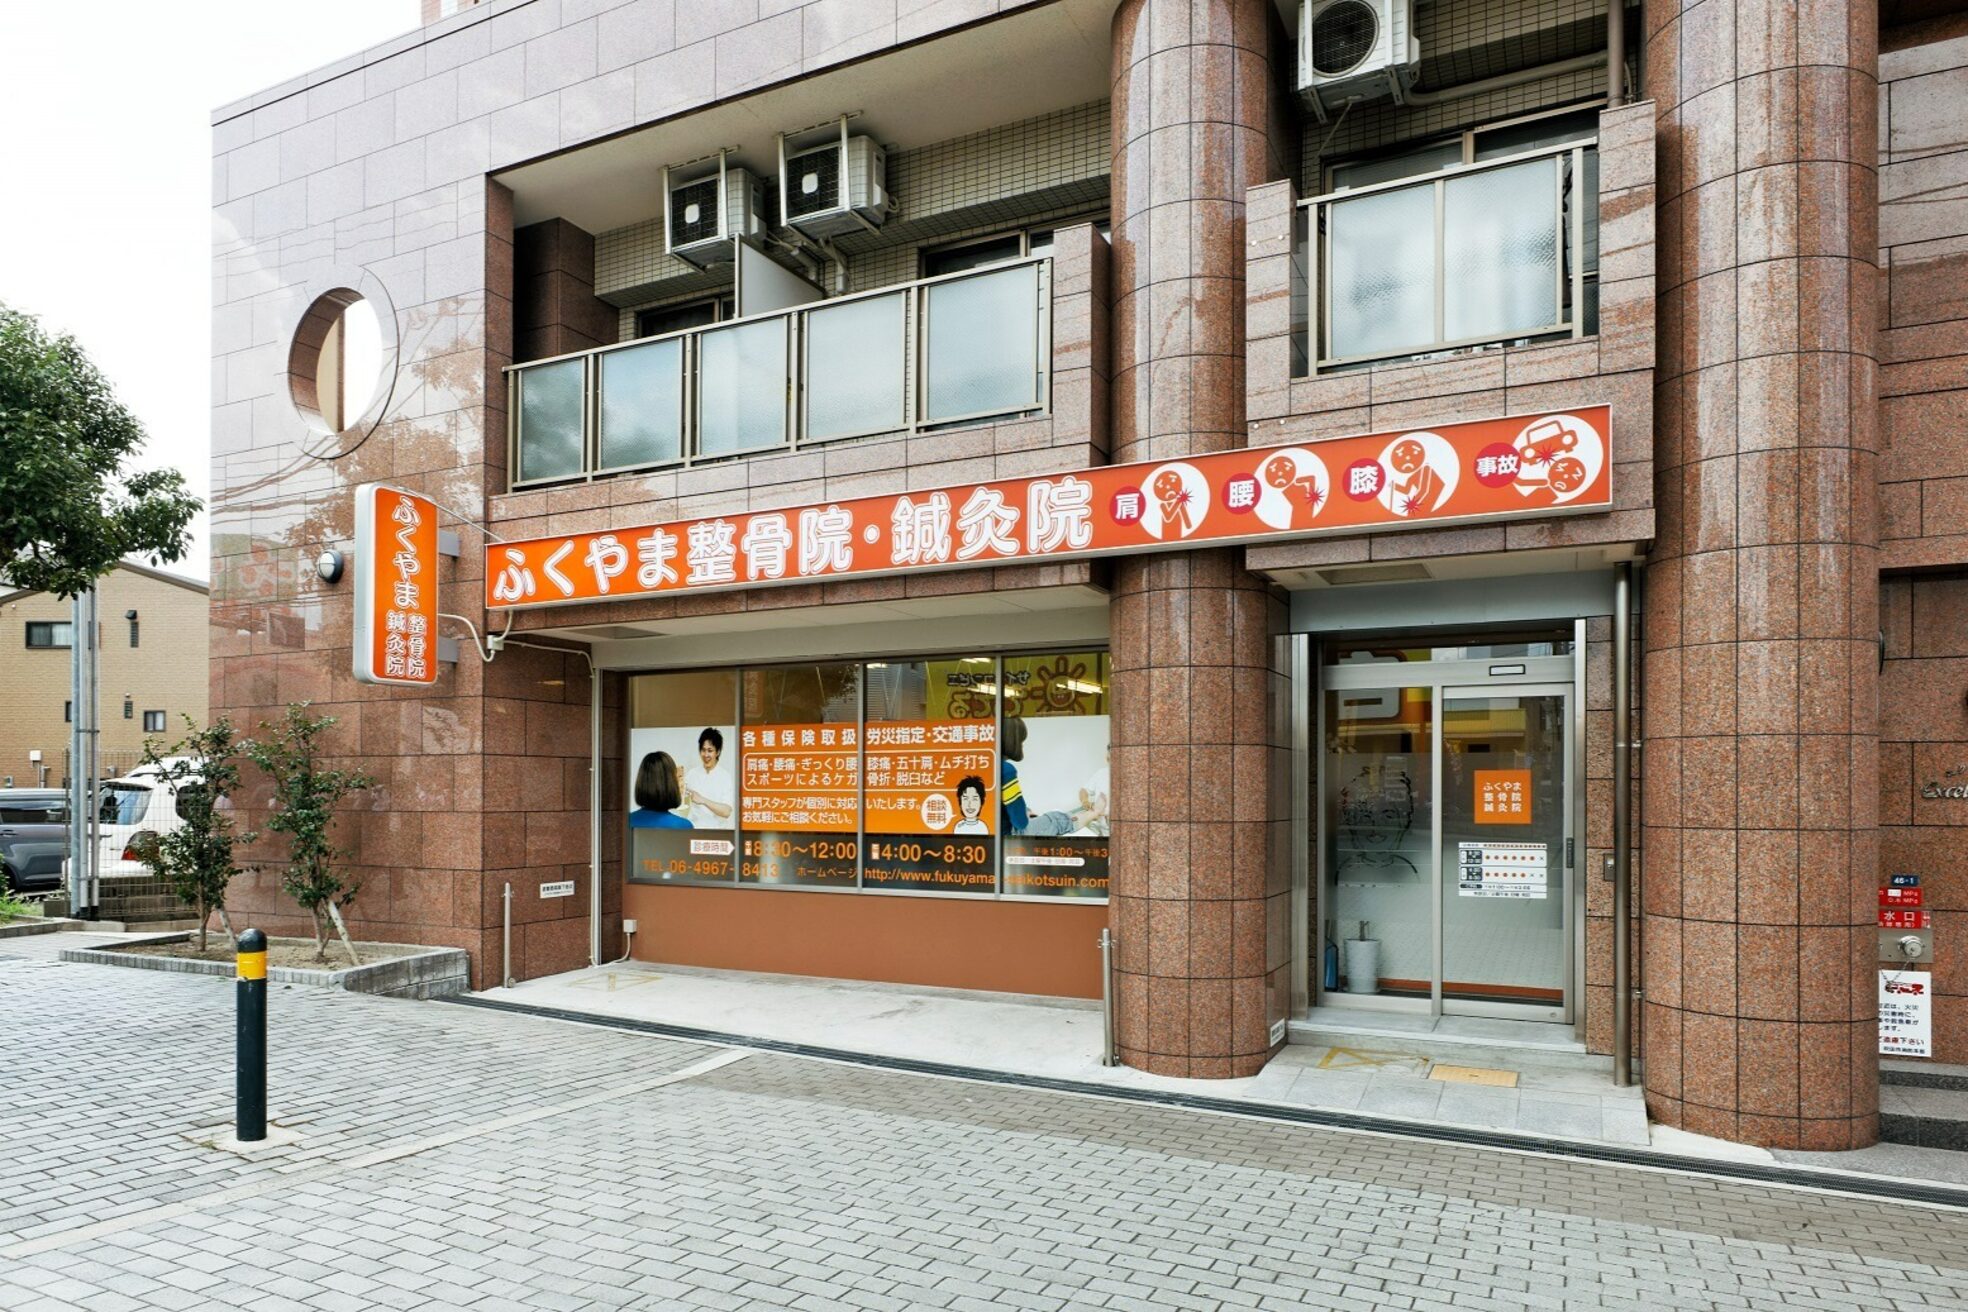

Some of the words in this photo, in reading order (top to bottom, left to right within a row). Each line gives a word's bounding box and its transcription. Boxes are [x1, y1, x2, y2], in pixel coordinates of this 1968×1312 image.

[1476, 453, 1519, 478] 事故
[1349, 465, 1379, 495] 膝
[1228, 479, 1256, 508] 腰
[1115, 492, 1140, 520] 肩
[493, 475, 1093, 601] ふくやま整骨院・鍼灸院
[392, 496, 421, 609] ふくやま
[407, 614, 427, 678] 整骨院
[743, 729, 857, 747] 各種保険取扱
[867, 724, 995, 745] 労災指定・交通事故
[747, 757, 858, 771] 肩痛・腰痛・ぎっくり腰
[867, 755, 990, 771] 膝痛・五十肩・ムチ打ち
[747, 772, 858, 786] スポーツによるケガ
[867, 771, 945, 786] 骨折・脱臼など
[1483, 782, 1522, 791] ふくやま
[742, 796, 858, 810] 専門スタッフが個別に対応
[866, 797, 921, 810] いたします。
[926, 799, 947, 812] 相談
[742, 811, 853, 825] お気軽にご相談ください。
[926, 812, 947, 825] 無料
[797, 867, 857, 880] ホームページ
[1884, 911, 1915, 922] 水口
